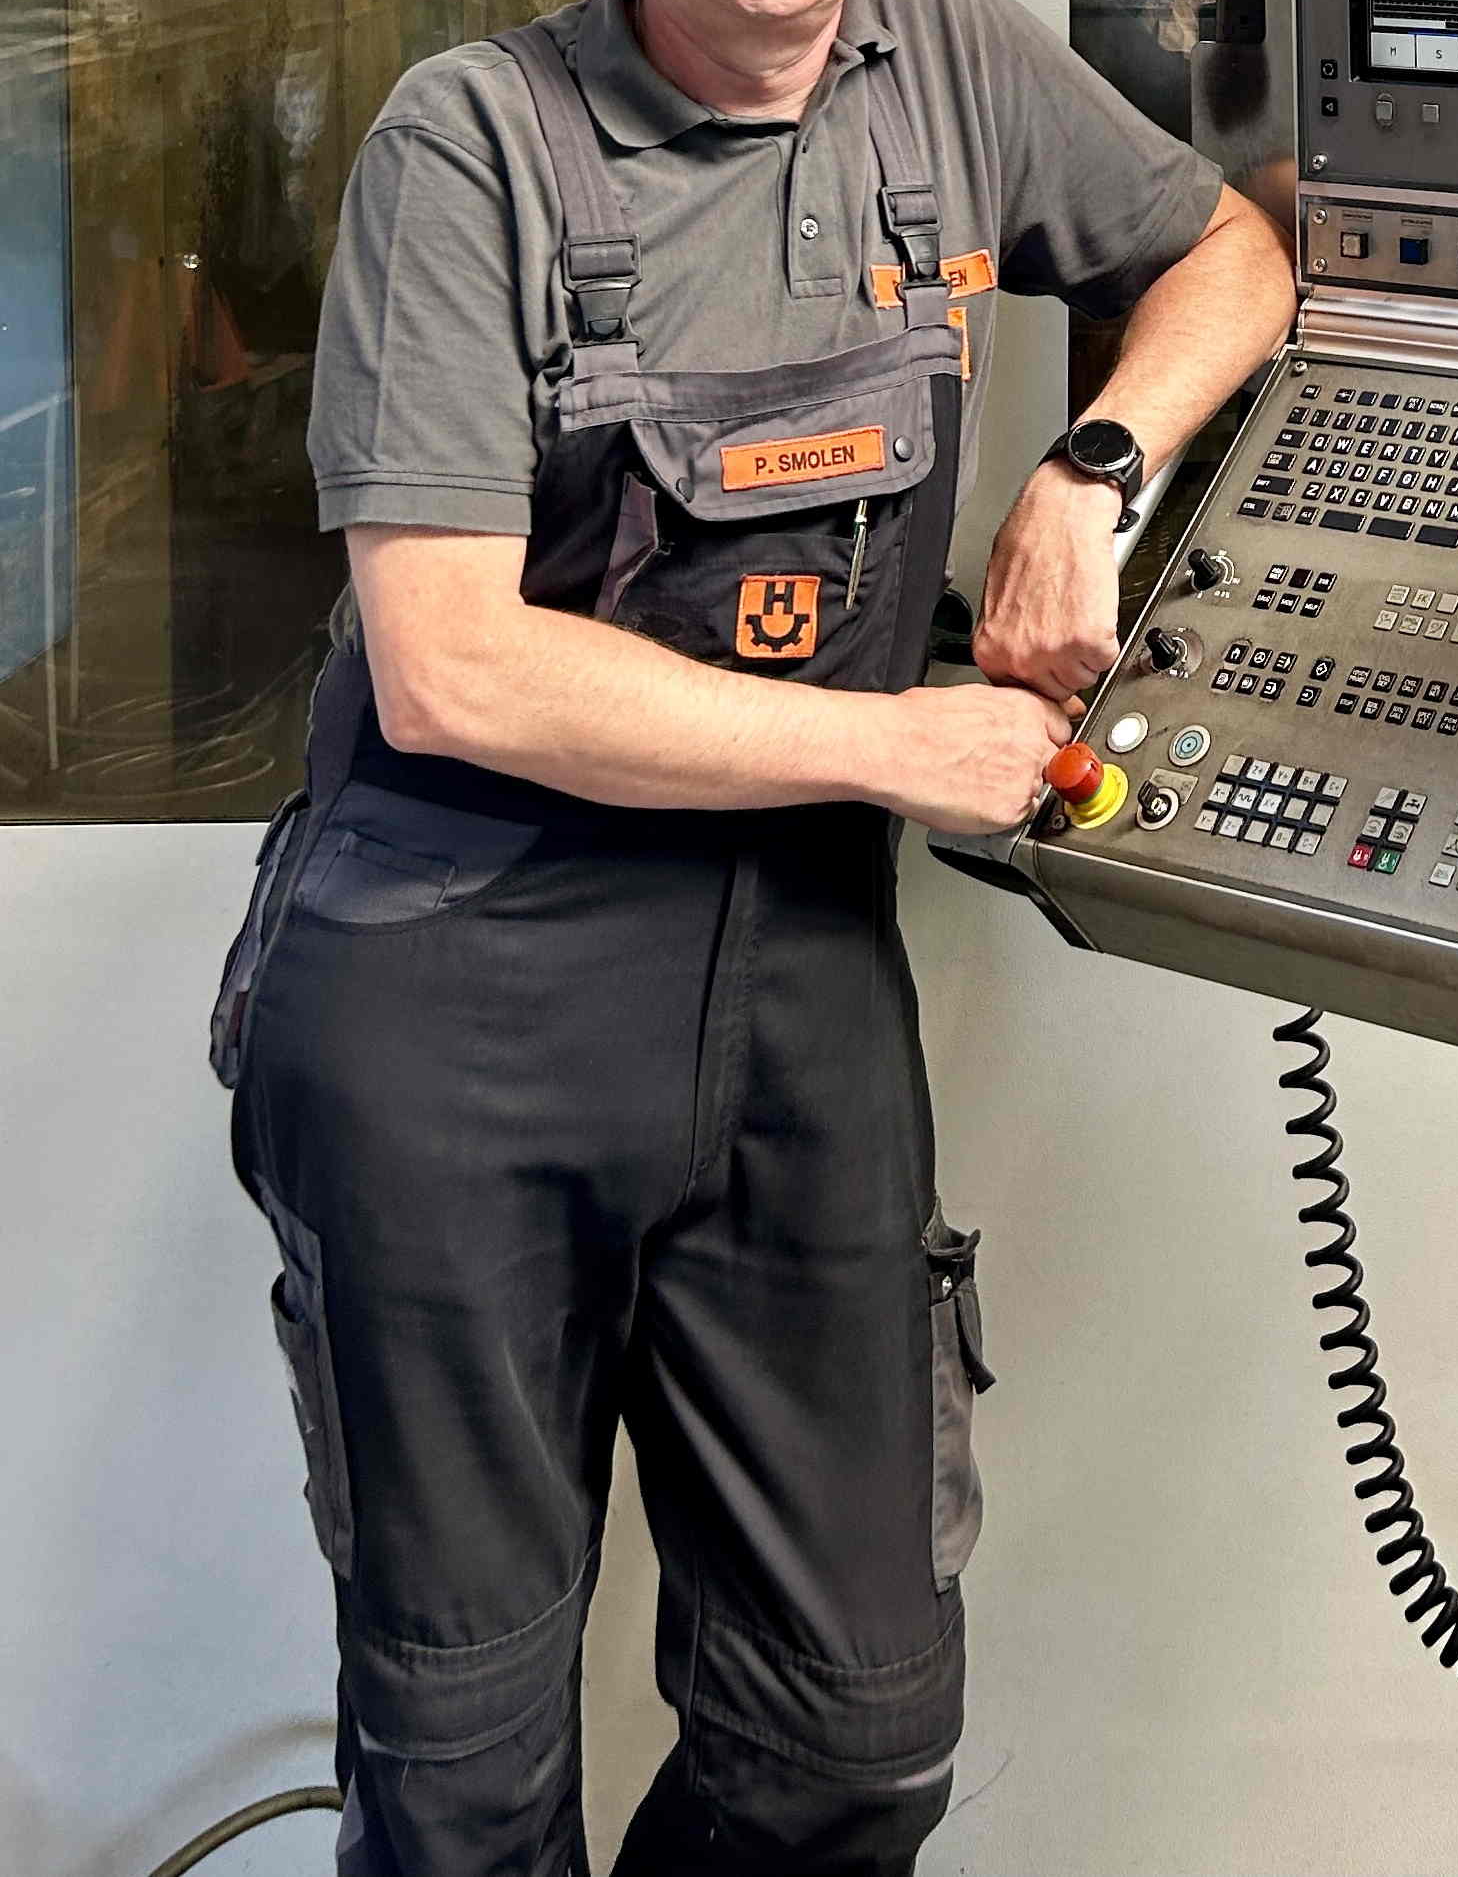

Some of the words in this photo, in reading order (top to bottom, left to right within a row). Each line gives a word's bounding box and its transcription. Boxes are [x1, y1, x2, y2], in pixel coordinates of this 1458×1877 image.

[1435, 49, 1443, 59] S
[755, 458, 775, 476] P.
[779, 446, 855, 472] SMOLEN
[1314, 437, 1324, 447] Q
[1336, 438, 1350, 449] W
[1361, 442, 1371, 454] E
[1383, 445, 1395, 456] R
[1409, 448, 1419, 460] T
[1433, 452, 1444, 463] Y
[1307, 459, 1318, 471] A
[1331, 463, 1341, 474] S
[1354, 466, 1365, 477] D
[1378, 469, 1389, 481] F
[1402, 473, 1412, 484] G
[1426, 477, 1437, 488] H
[1306, 485, 1319, 496] Z
[1330, 488, 1341, 499] X
[1355, 491, 1365, 502] C
[1381, 495, 1390, 507] V
[1402, 499, 1412, 510] B
[1426, 502, 1437, 513] N
[1252, 765, 1263, 775] Z+
[1215, 788, 1225, 796] X-
